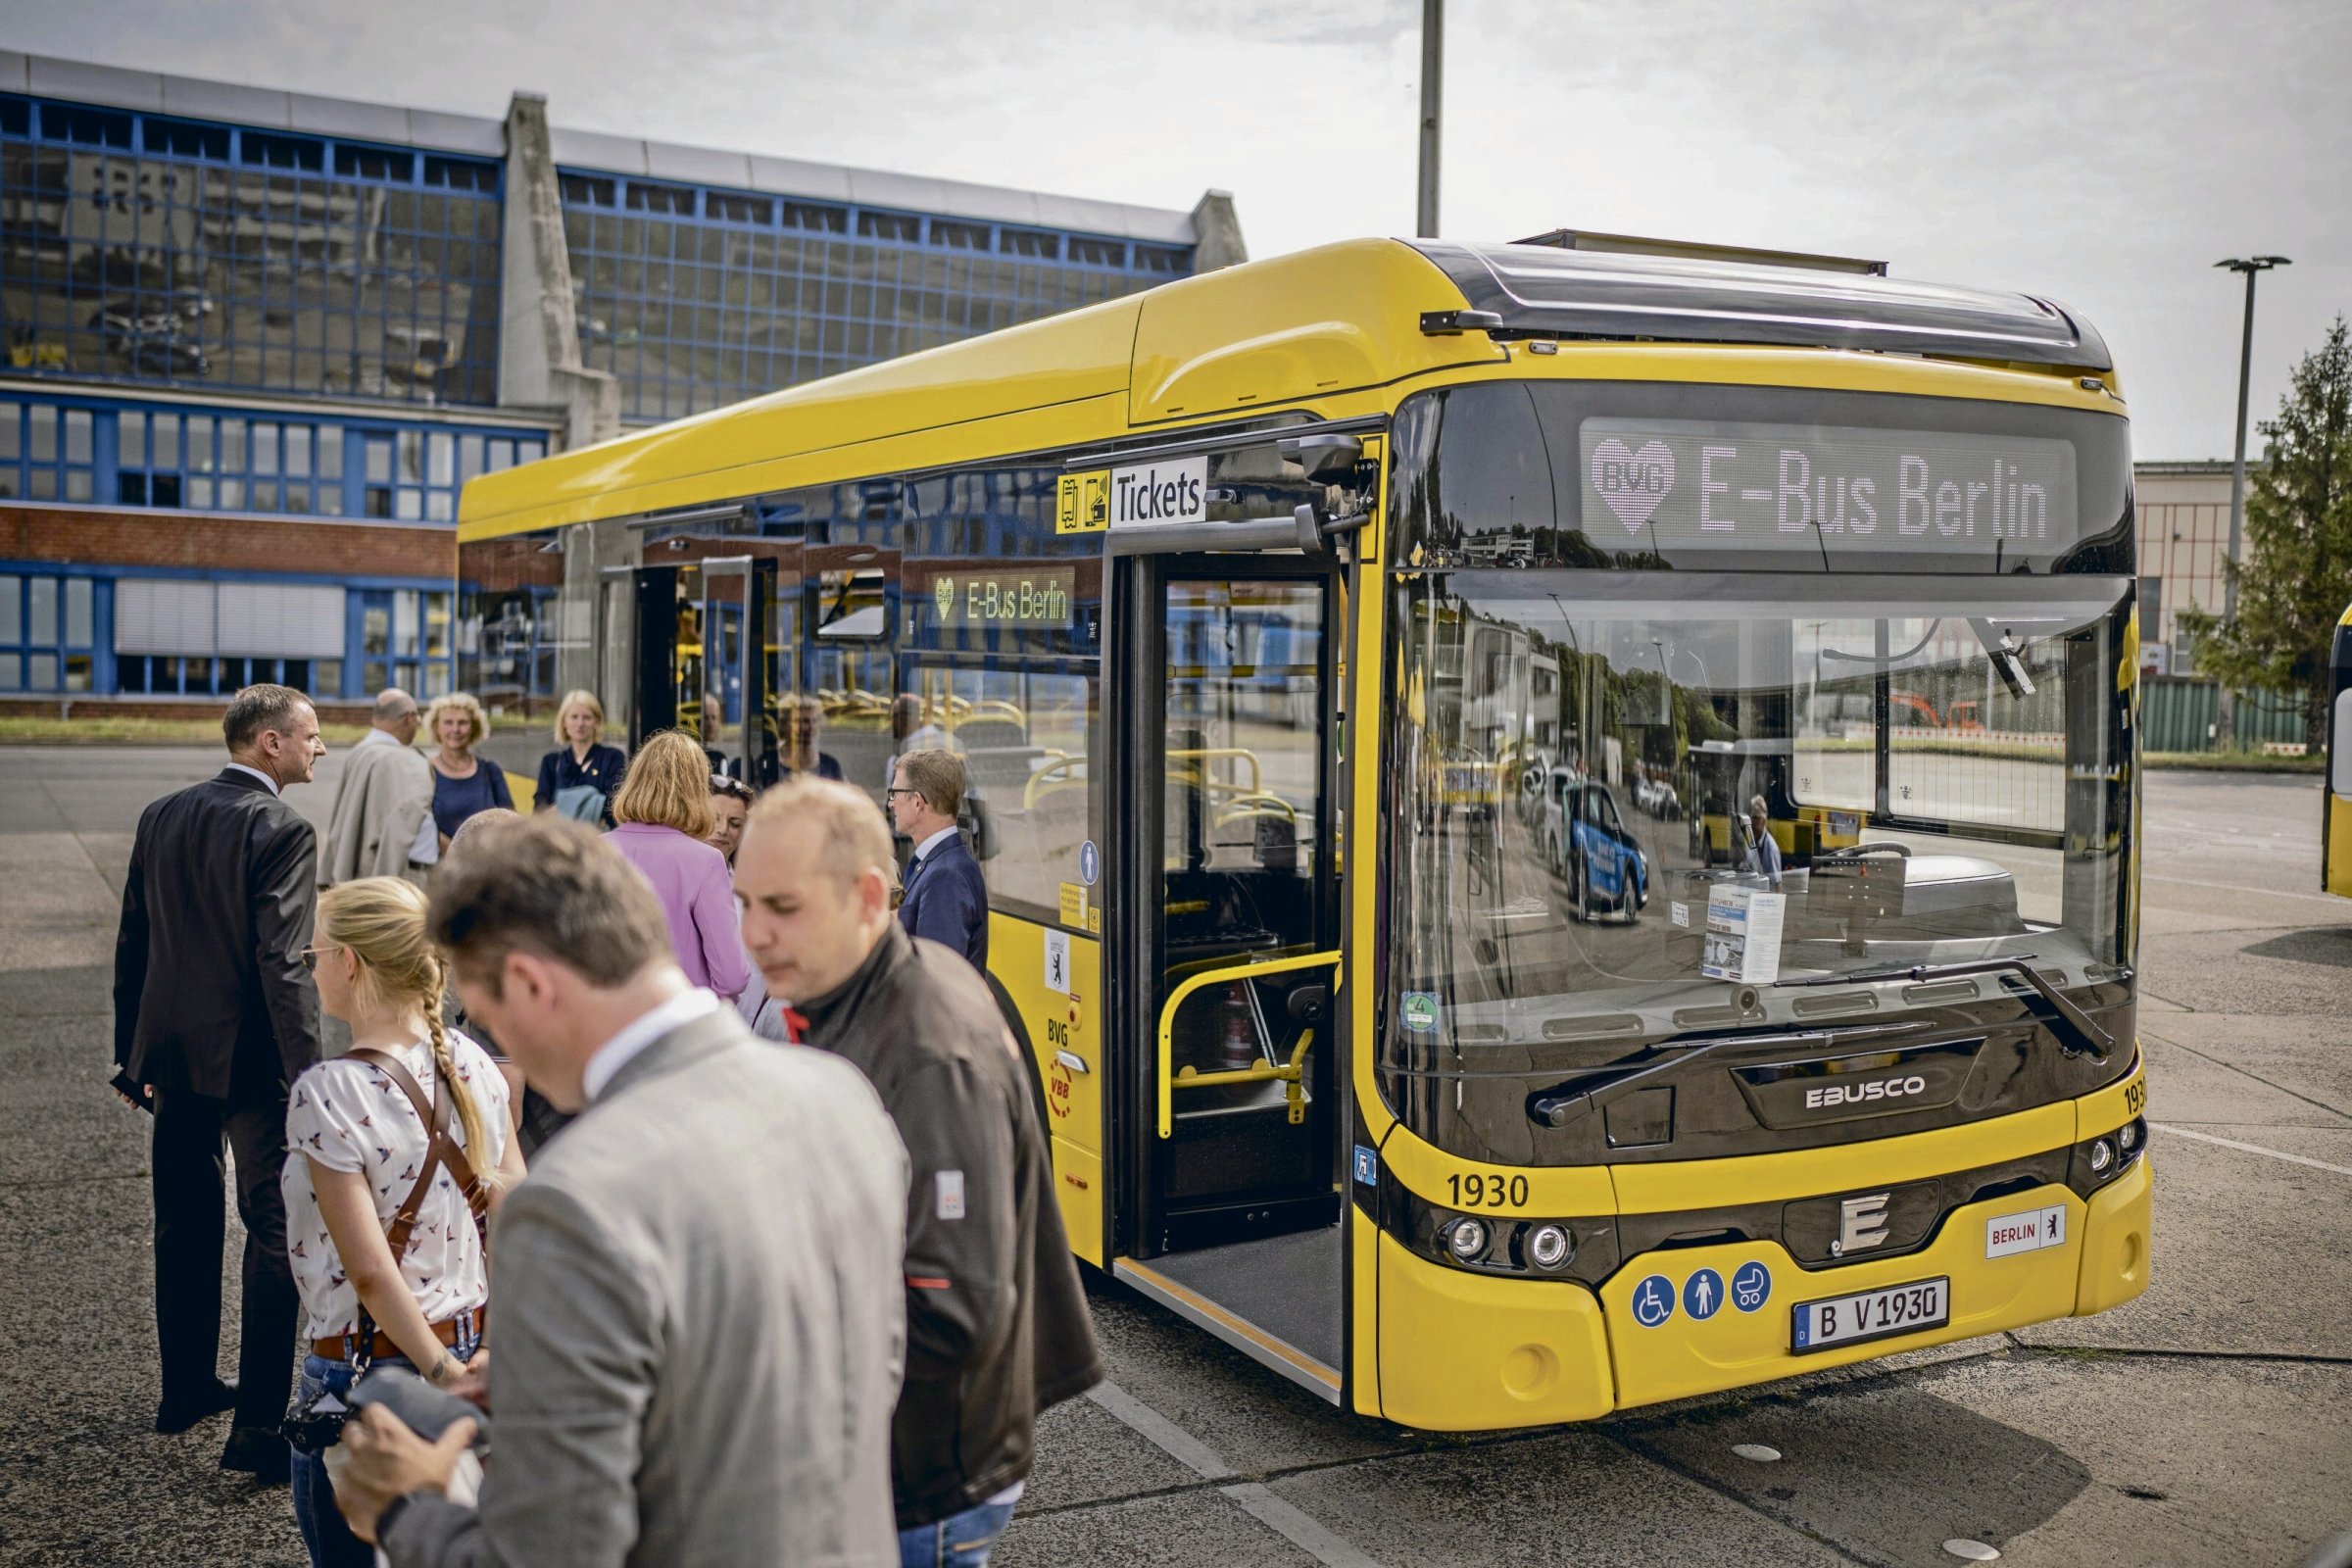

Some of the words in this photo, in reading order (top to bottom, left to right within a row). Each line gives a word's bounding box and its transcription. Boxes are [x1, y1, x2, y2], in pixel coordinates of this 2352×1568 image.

[1602, 462, 1665, 494] BVG
[1700, 446, 1878, 535] E-Bus
[1898, 455, 2046, 539] Berlin
[1117, 469, 1200, 521] Tickets
[966, 581, 1016, 619] E-Bus
[1019, 579, 1066, 619] Berlin
[1414, 997, 1426, 1013] 4
[1048, 1018, 1068, 1048] BVG
[1051, 1076, 1070, 1100] VBB
[1805, 1076, 1926, 1109] EBUSCO
[1446, 1173, 1530, 1208] 1930
[1991, 1223, 2035, 1246] BERLIN
[1821, 1305, 1837, 1339] B
